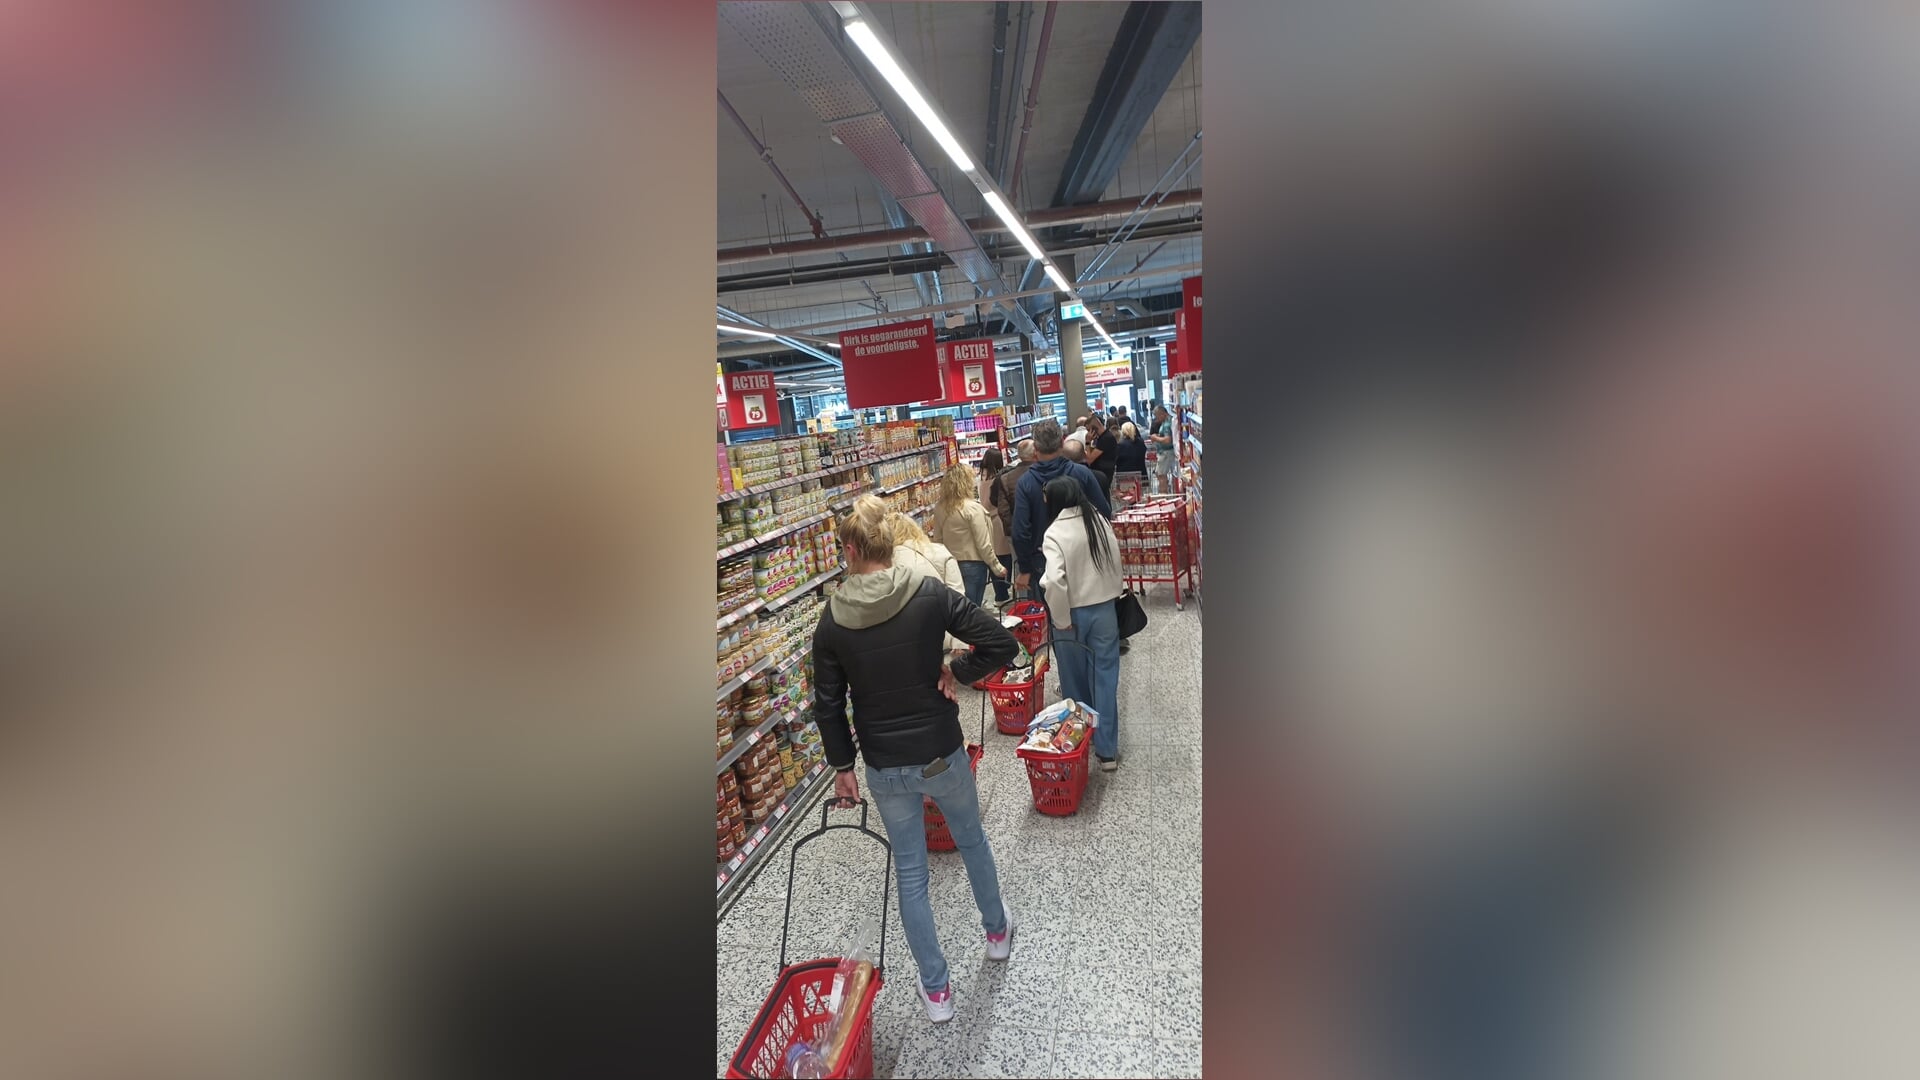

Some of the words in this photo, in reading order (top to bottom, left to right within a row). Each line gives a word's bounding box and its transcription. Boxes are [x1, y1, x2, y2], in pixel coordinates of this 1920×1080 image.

[843, 335, 861, 346] Dirk
[861, 333, 870, 344] is
[870, 325, 928, 343] gegarandeerd
[855, 346, 866, 357] de
[866, 339, 920, 354] voordeligste.
[954, 343, 989, 361] ACTIE!
[1117, 366, 1130, 375] Dirk
[732, 374, 770, 391] ACTIE!
